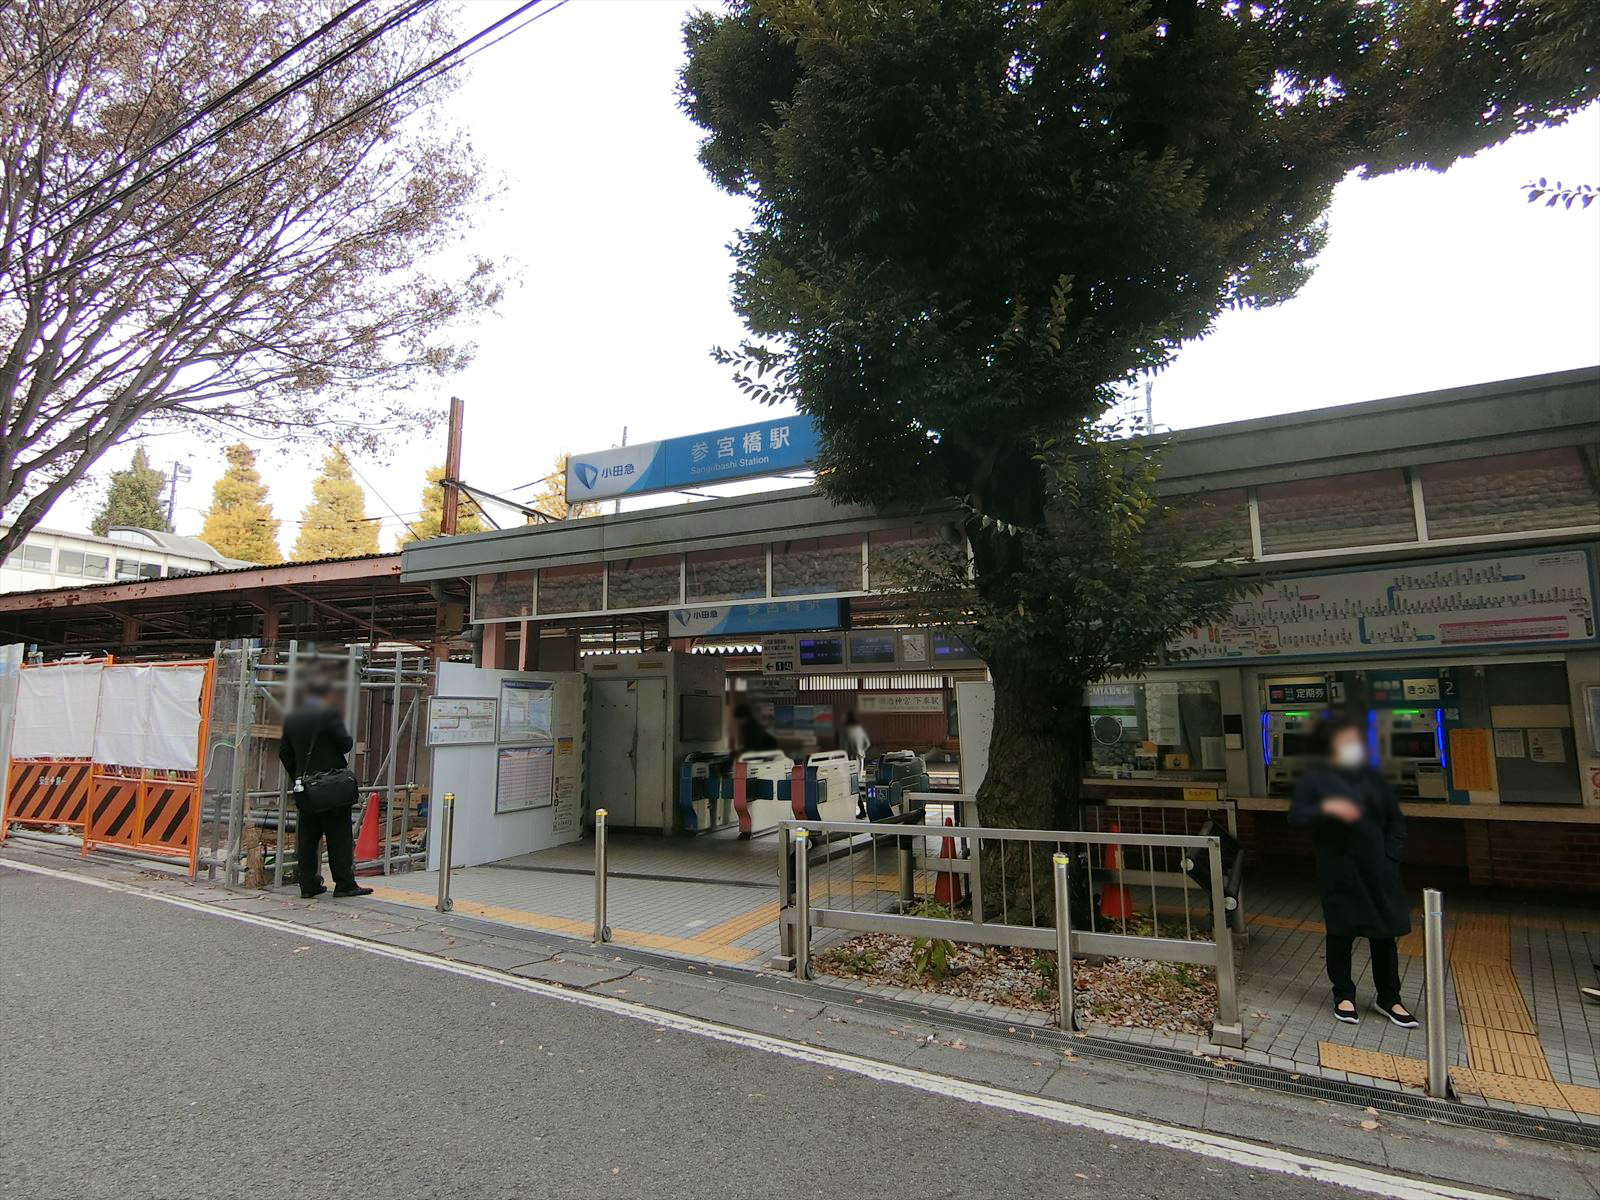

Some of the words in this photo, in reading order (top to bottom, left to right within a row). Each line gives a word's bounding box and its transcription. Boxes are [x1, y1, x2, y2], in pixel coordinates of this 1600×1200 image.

[691, 425, 790, 463] 参宮橋駅
[601, 462, 636, 479] 小田急
[691, 461, 738, 475] Sangubashi
[738, 454, 769, 468] Station
[693, 609, 719, 620] 小田急
[1296, 687, 1324, 699] 定期券
[1408, 685, 1437, 695] きっぷ
[1445, 681, 1455, 696] 2
